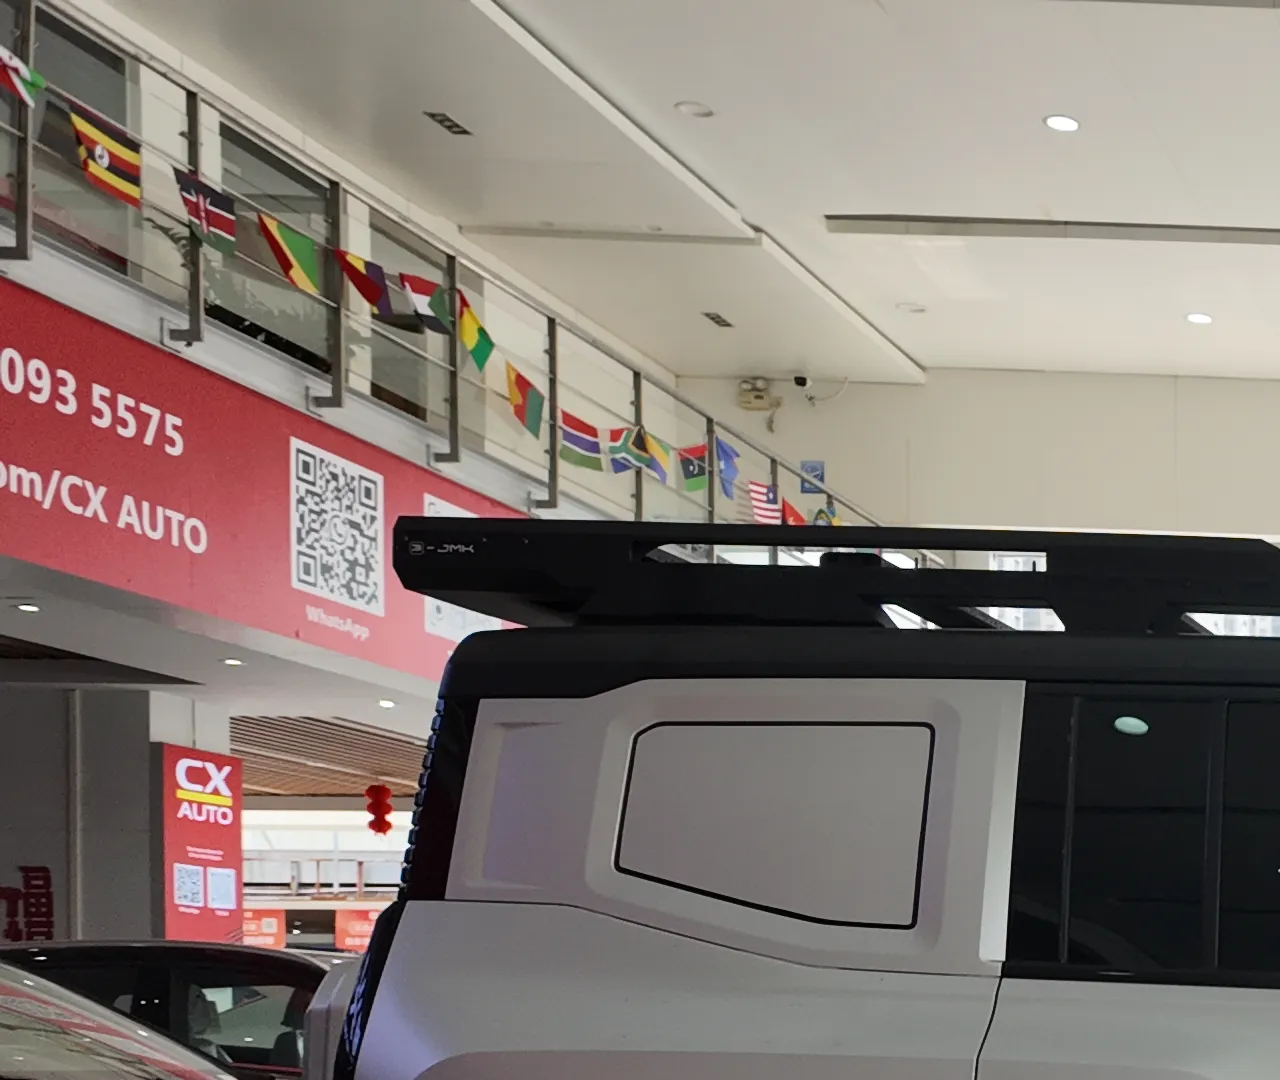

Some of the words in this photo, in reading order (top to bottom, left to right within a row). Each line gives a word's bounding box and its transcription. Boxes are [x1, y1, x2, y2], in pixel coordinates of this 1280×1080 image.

[0, 347, 78, 416] 093
[91, 382, 184, 457] 5575
[116, 494, 208, 554] AUTO
[305, 604, 370, 642] WhatsApp
[175, 757, 233, 797] CX
[177, 802, 234, 826] AUTO
